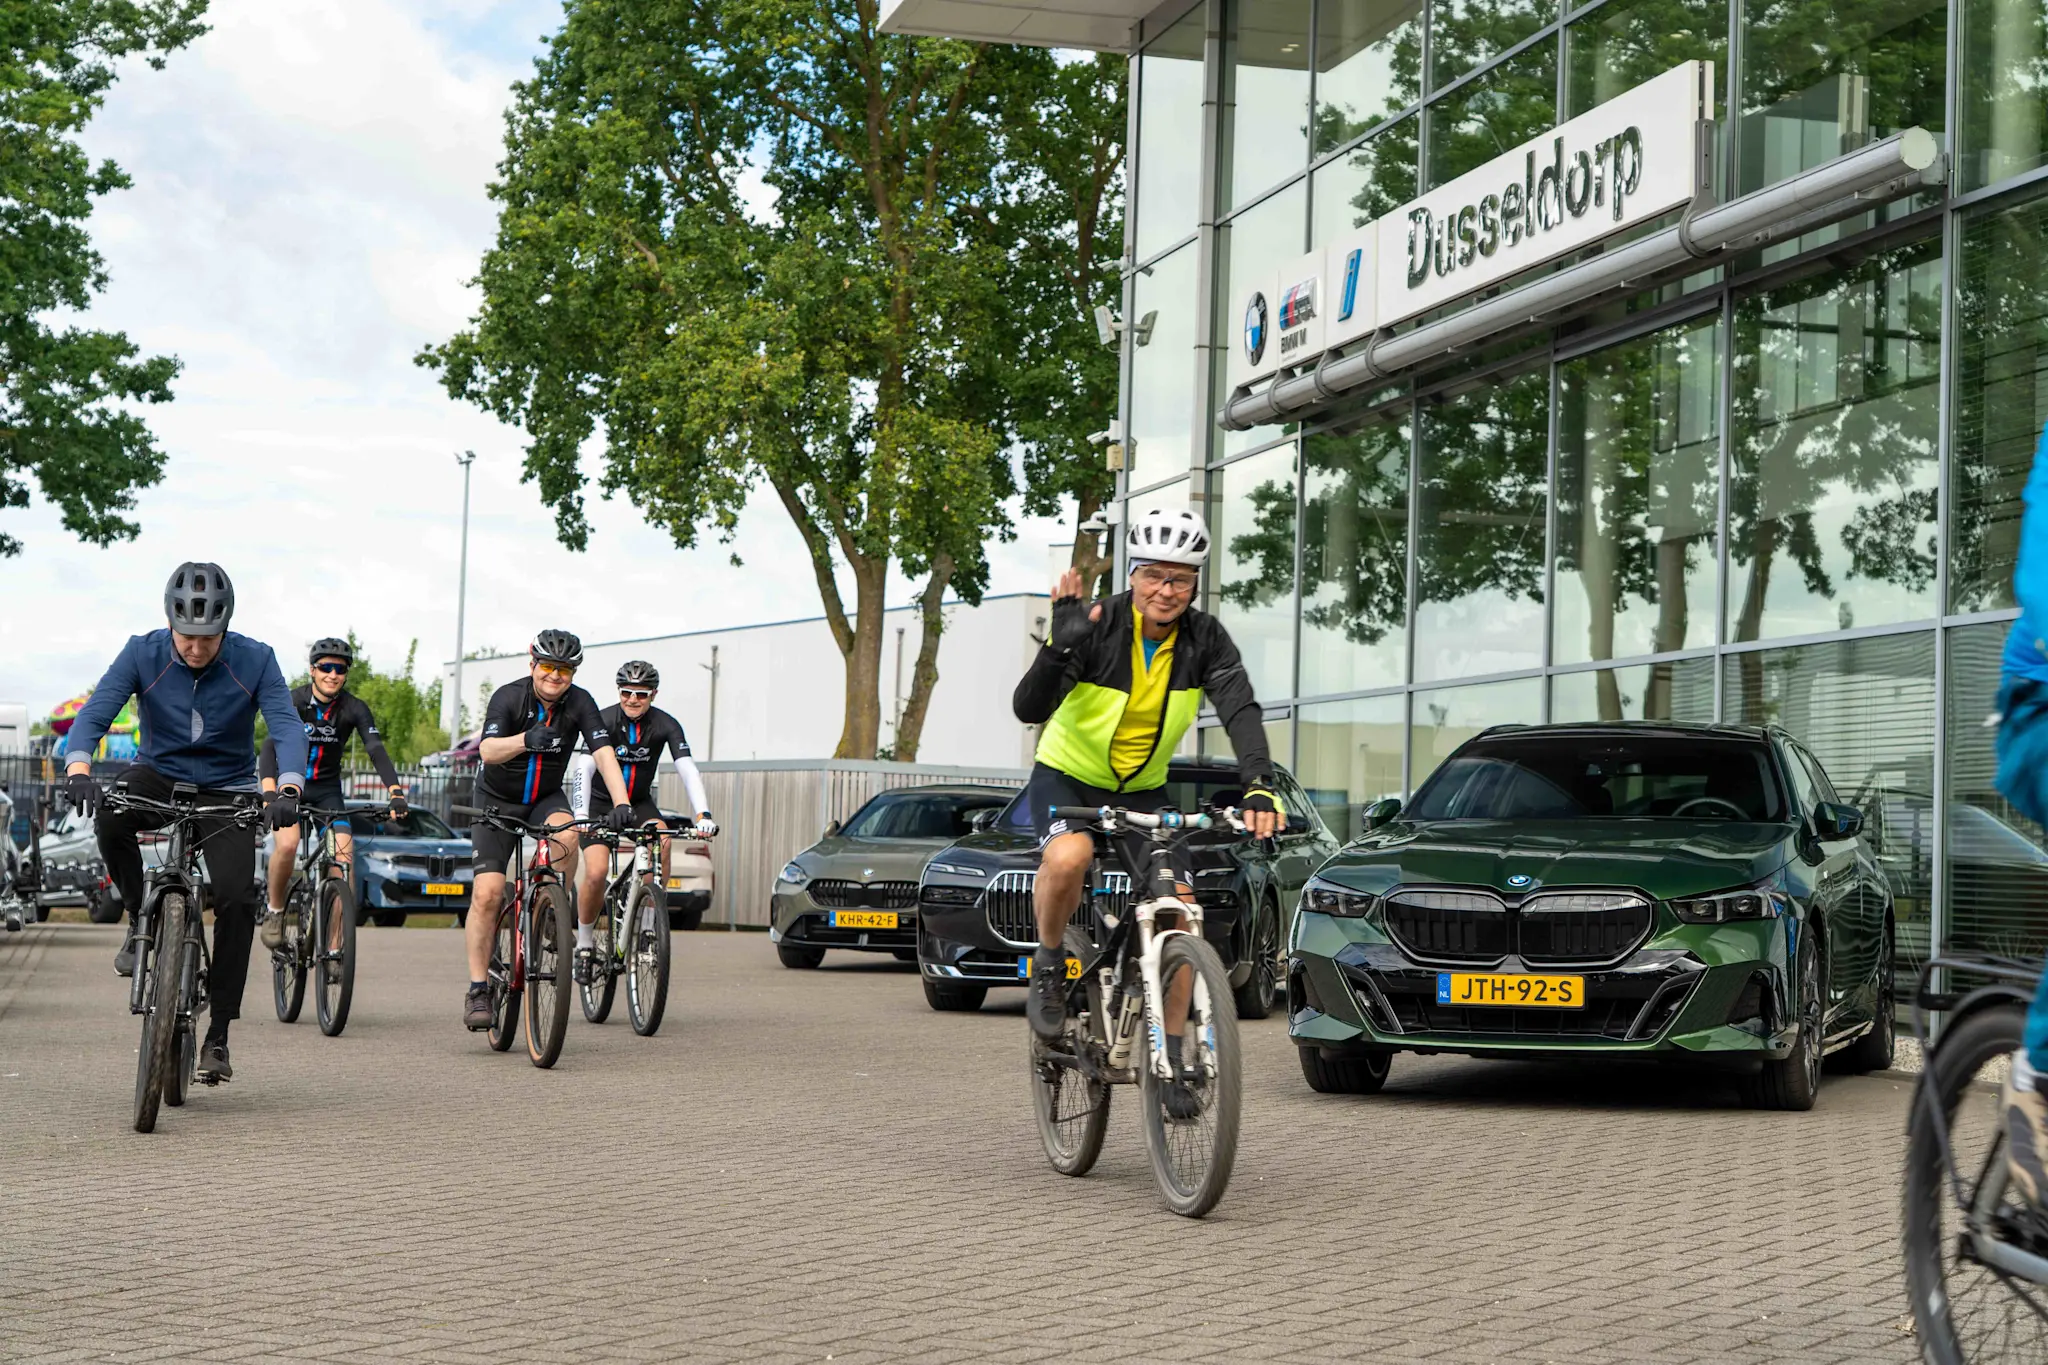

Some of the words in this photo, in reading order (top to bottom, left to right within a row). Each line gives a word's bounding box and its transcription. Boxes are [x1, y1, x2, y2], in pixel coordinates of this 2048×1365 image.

[1407, 126, 1643, 289] Dusseldorp
[1281, 330, 1299, 354] BMW
[840, 914, 893, 926] KHR-42-F
[1461, 978, 1572, 1002] JTH-92-S
